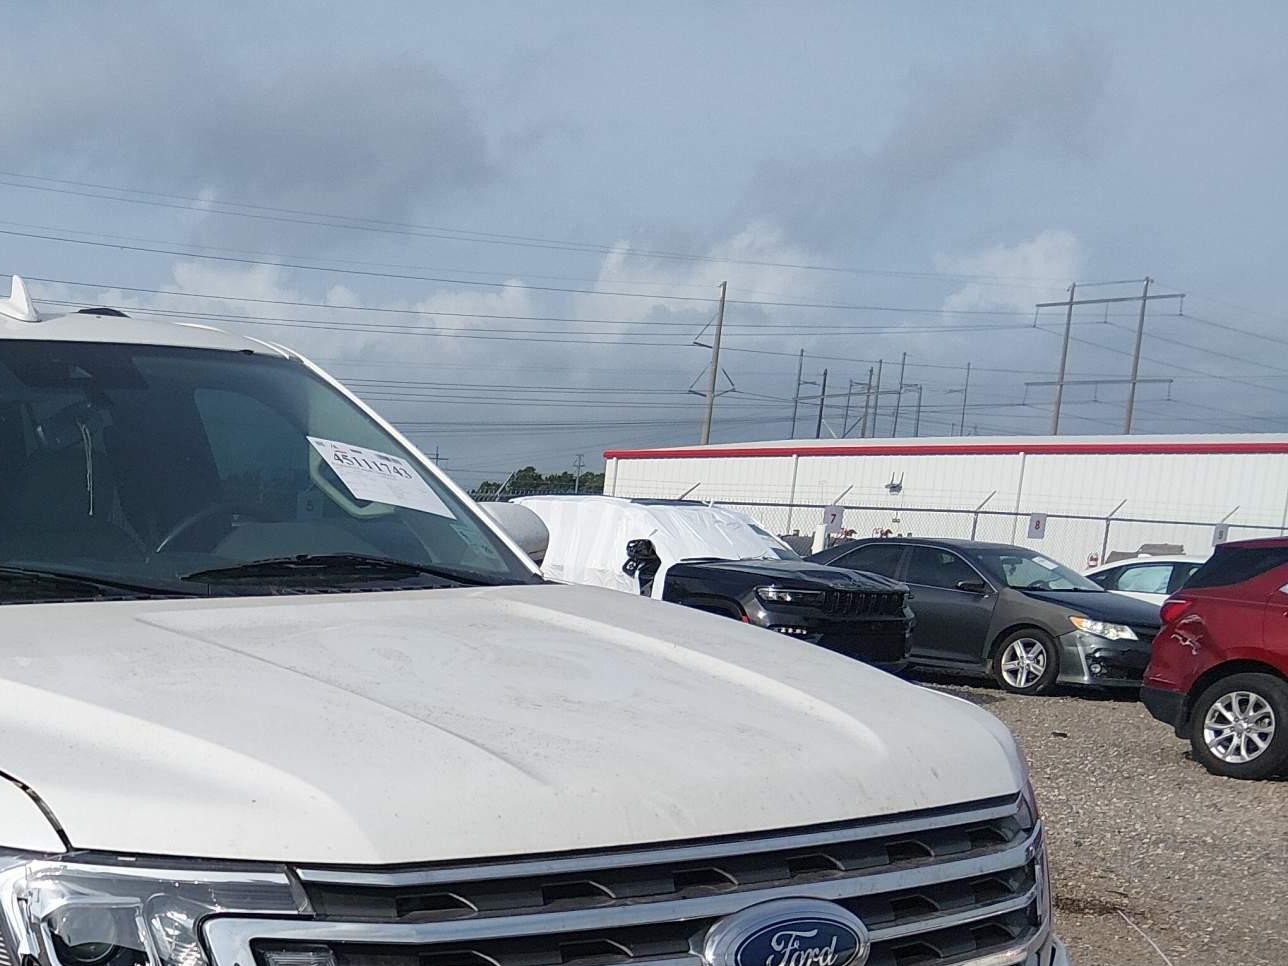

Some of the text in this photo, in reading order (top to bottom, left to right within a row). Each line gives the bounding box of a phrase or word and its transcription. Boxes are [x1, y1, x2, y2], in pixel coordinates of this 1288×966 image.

[333, 452, 413, 480] 45111743
[830, 513, 837, 524] 7
[1034, 520, 1041, 530] 8
